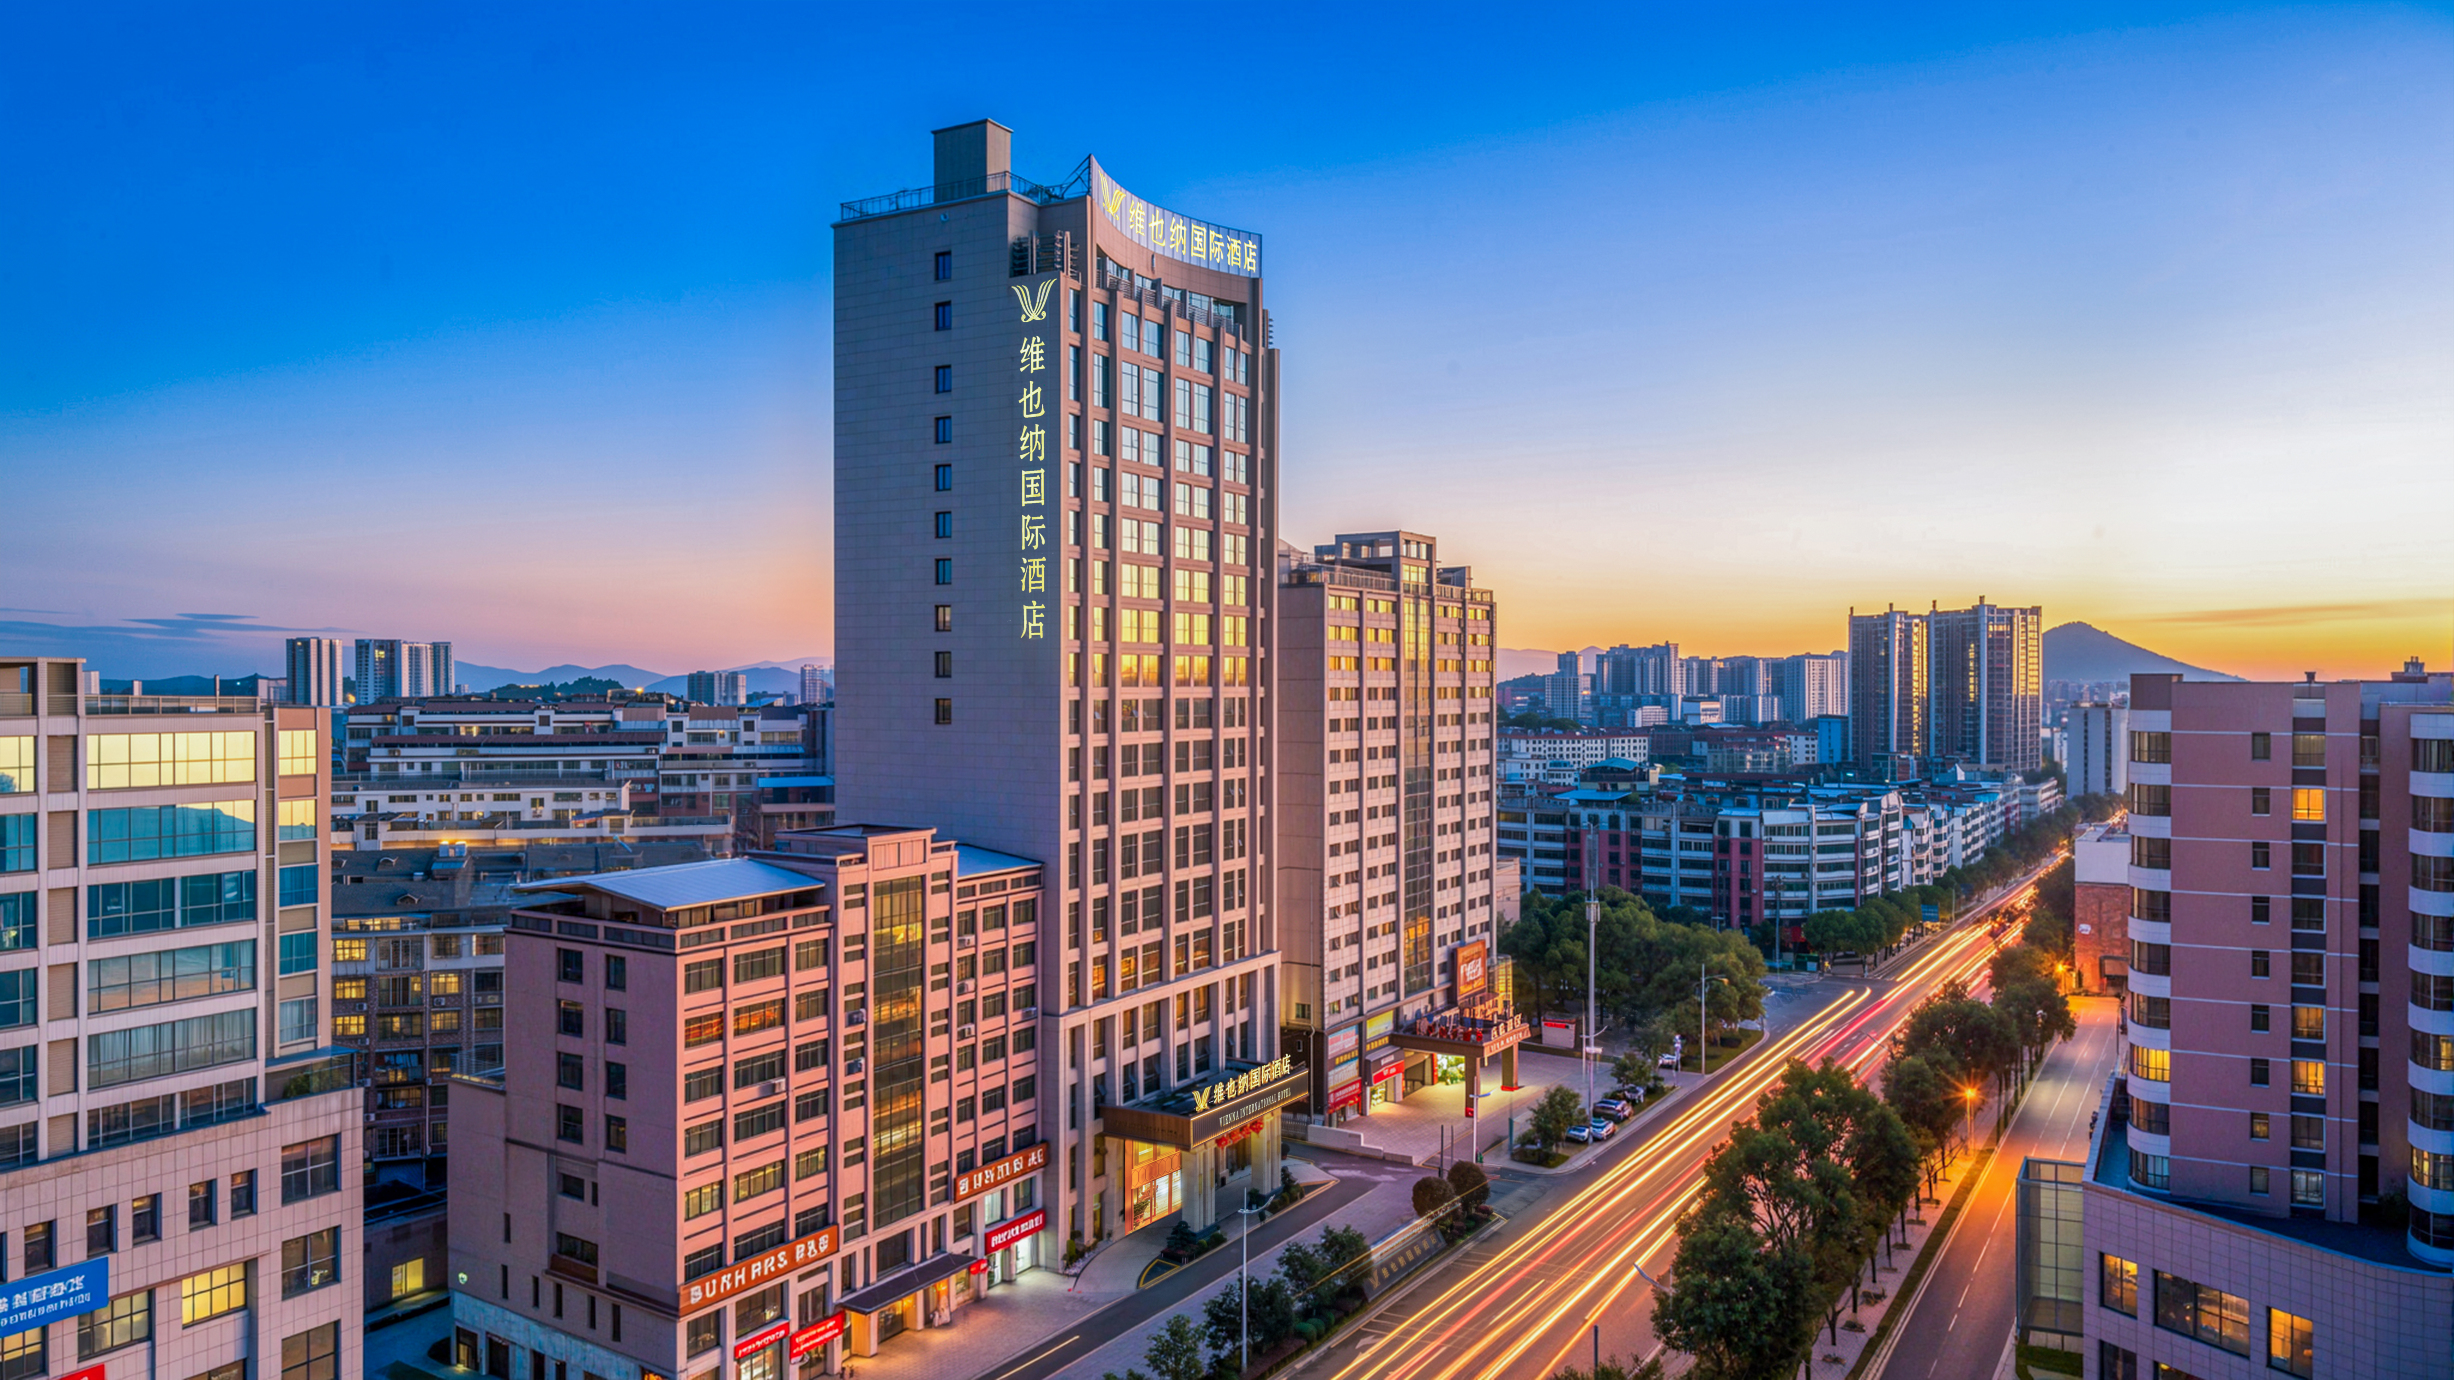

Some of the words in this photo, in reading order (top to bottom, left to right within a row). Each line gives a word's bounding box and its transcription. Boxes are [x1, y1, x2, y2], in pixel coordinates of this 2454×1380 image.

[1129, 199, 1257, 273] 维也纳国际酒店
[1018, 335, 1046, 639] 维也纳国际酒店
[1213, 1053, 1292, 1104] 维也纳国际酒店
[1219, 1110, 1239, 1127] VIENNA
[1277, 1087, 1292, 1102] HOTEL
